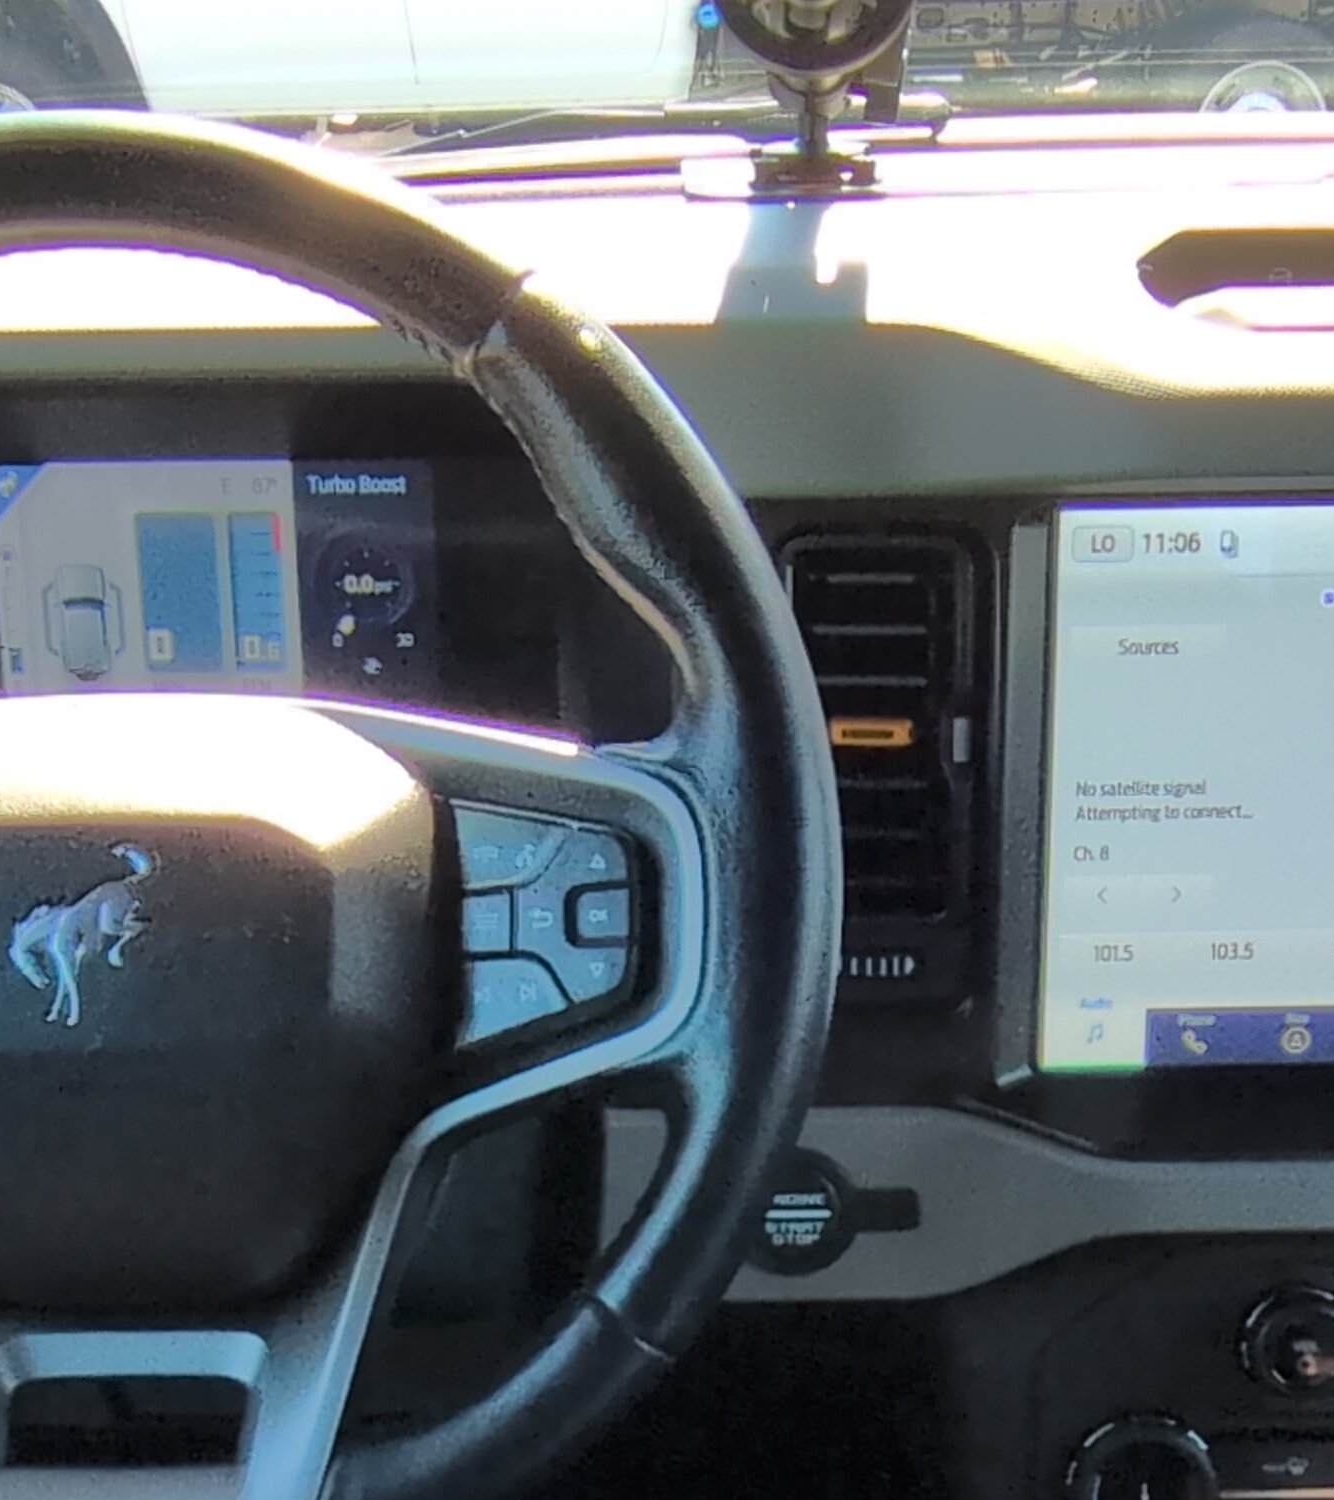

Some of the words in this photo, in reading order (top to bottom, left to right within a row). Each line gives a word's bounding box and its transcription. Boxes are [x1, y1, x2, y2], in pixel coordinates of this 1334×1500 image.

[306, 473, 356, 494] Turbo
[359, 473, 407, 495] Boost
[1091, 533, 1115, 553] LO
[1143, 531, 1201, 554] 11:06
[1117, 638, 1180, 656] Sources
[1075, 782, 1096, 797] No
[1100, 780, 1159, 796] satellite
[1163, 780, 1207, 798] signal
[1074, 805, 1160, 822] Attempting
[1164, 805, 1180, 820] to
[1073, 846, 1094, 862] Ch.
[1211, 943, 1254, 960] 103.5
